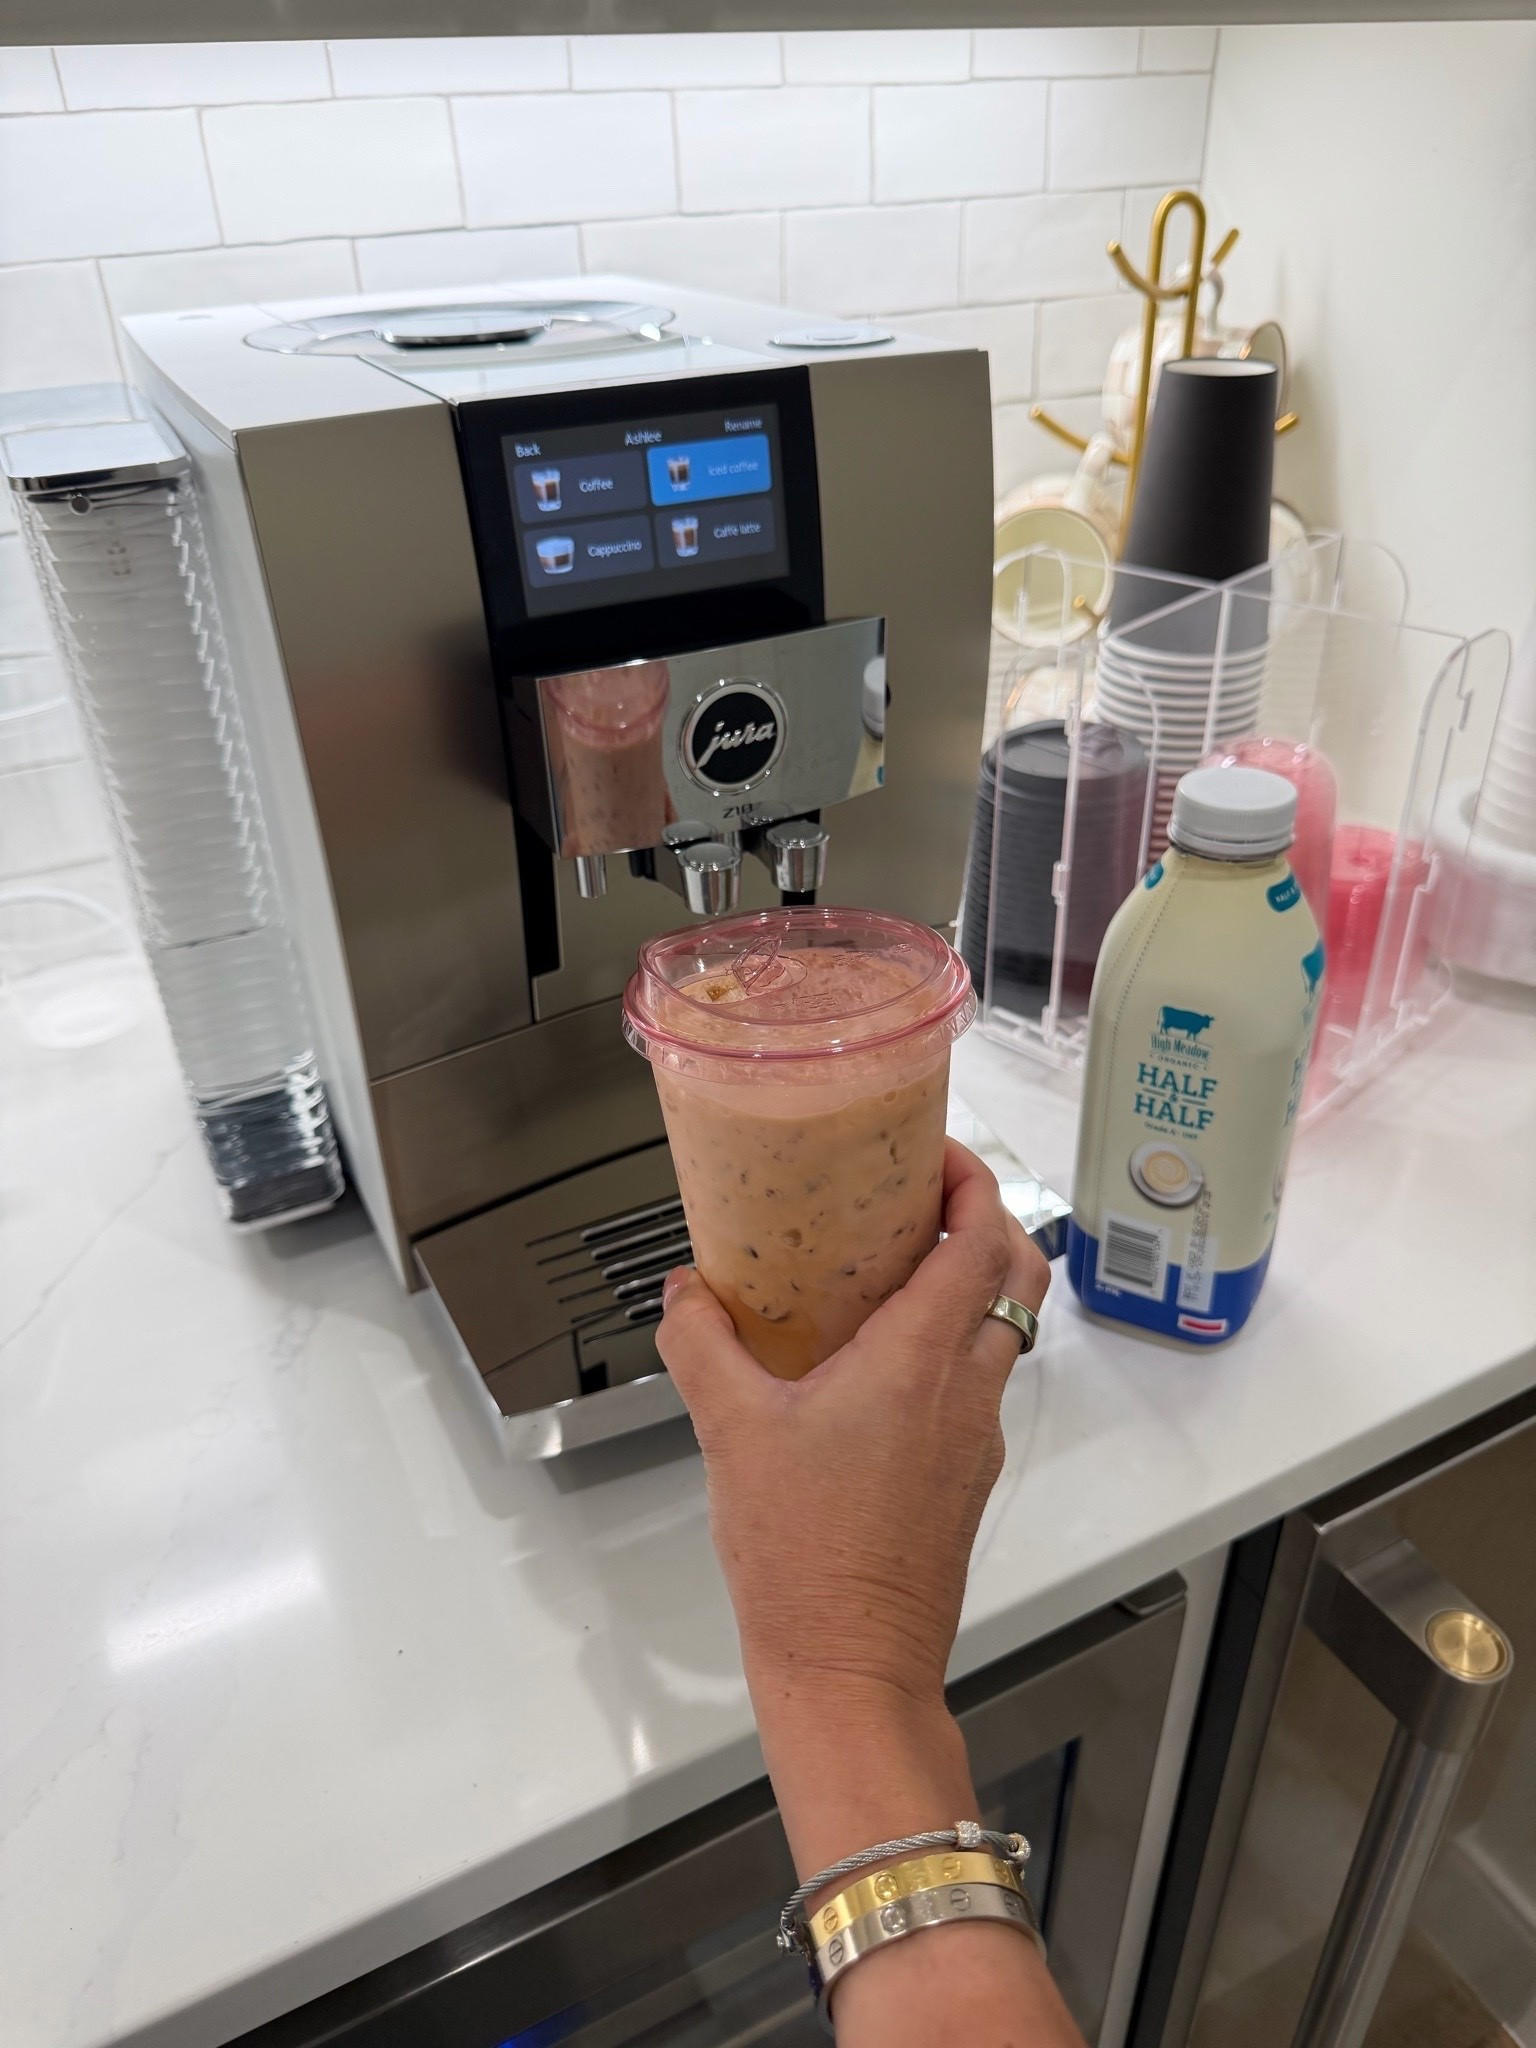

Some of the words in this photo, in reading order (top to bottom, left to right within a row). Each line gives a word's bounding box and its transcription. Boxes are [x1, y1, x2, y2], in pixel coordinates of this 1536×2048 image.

[724, 418, 763, 432] Rename
[515, 444, 541, 458] Back
[578, 478, 614, 493] Coffee
[739, 521, 762, 535] latte
[588, 540, 642, 558] Cappuccino
[722, 803, 753, 819] Z10
[1150, 1033, 1172, 1053] High
[1173, 1038, 1210, 1062] Meadow
[1136, 1061, 1218, 1100] HALF
[1167, 1092, 1178, 1104] &
[1133, 1092, 1215, 1131] HALF
